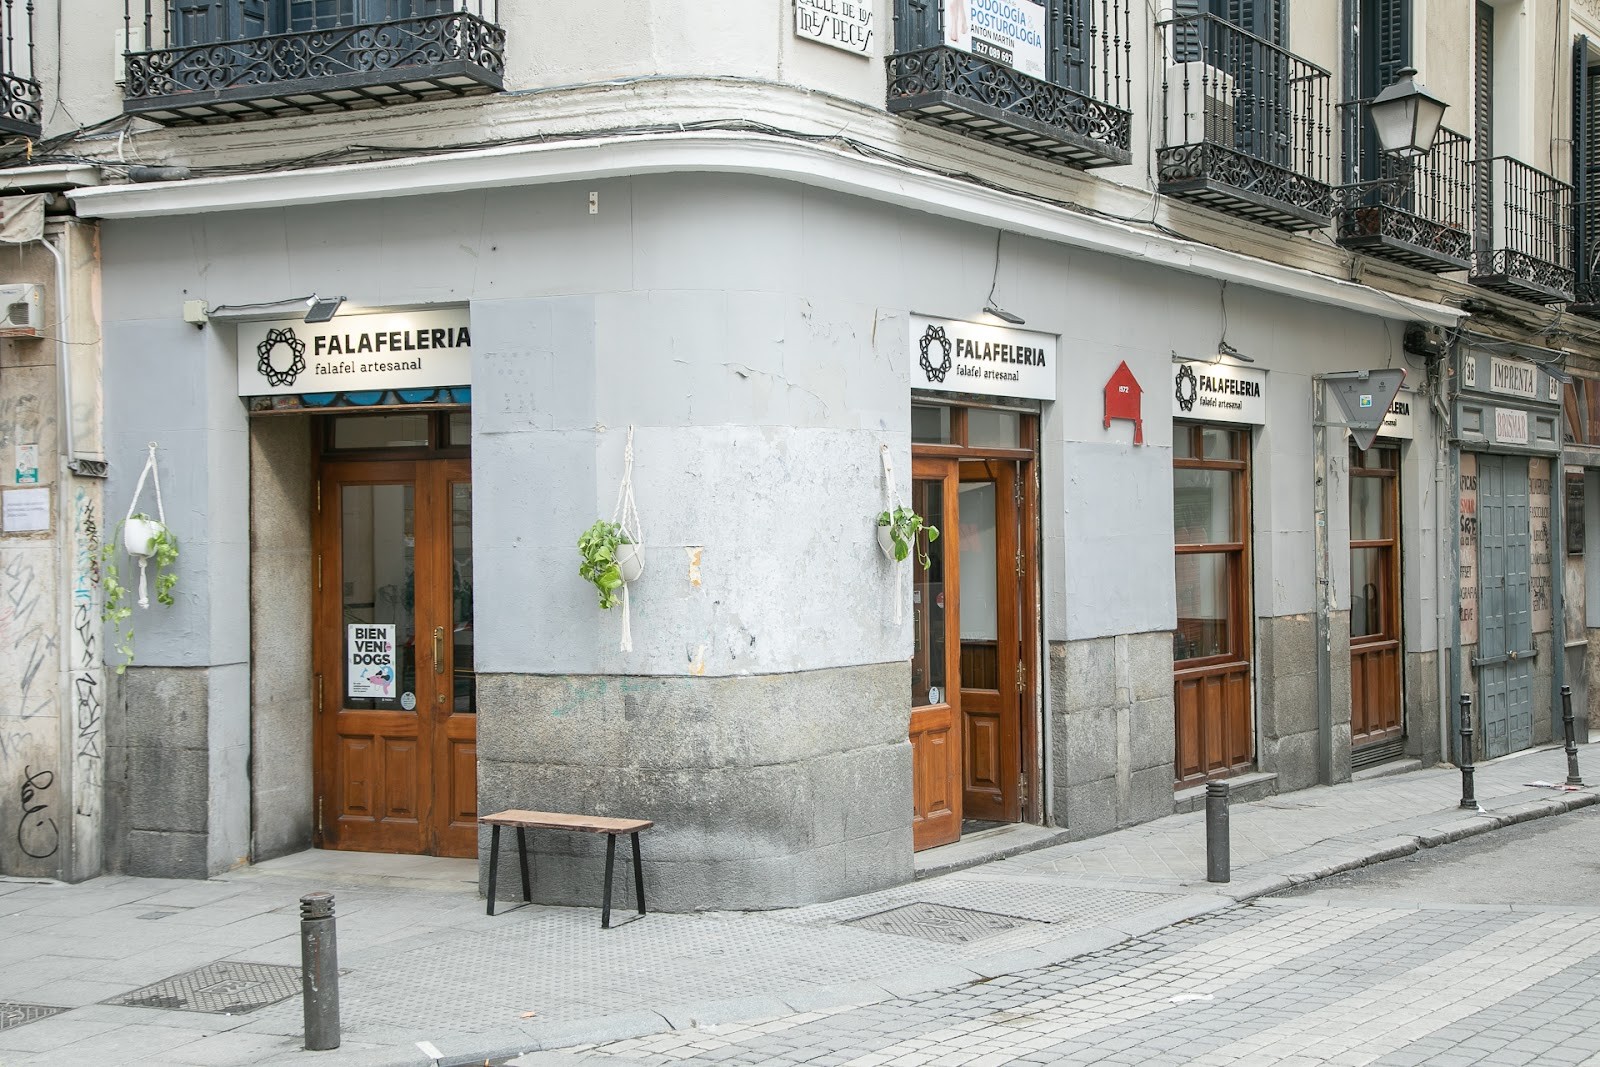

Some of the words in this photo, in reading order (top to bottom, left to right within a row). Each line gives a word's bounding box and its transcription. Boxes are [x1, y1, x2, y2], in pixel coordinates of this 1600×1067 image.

[842, 2, 855, 18] DE
[859, 8, 873, 26] LOS
[798, 6, 829, 36] TRES
[831, 16, 873, 51] PECES
[971, 7, 1042, 48] POSTUROLOGÍA
[976, 41, 988, 55] 627
[1001, 51, 1013, 64] 692
[314, 326, 471, 356] FALAFELERIA
[956, 338, 1046, 367] FALAFELERIA
[315, 361, 355, 375] falafel
[360, 358, 422, 373] artesanal
[956, 364, 982, 378] falafel
[984, 370, 1019, 381] artesanal
[1466, 362, 1475, 381] 36
[1199, 375, 1260, 397] FALAFELERIA
[1494, 363, 1534, 393] IMPRENTA
[355, 628, 387, 640] BIEN
[355, 641, 387, 652] VENI
[353, 654, 391, 666] DOGS
